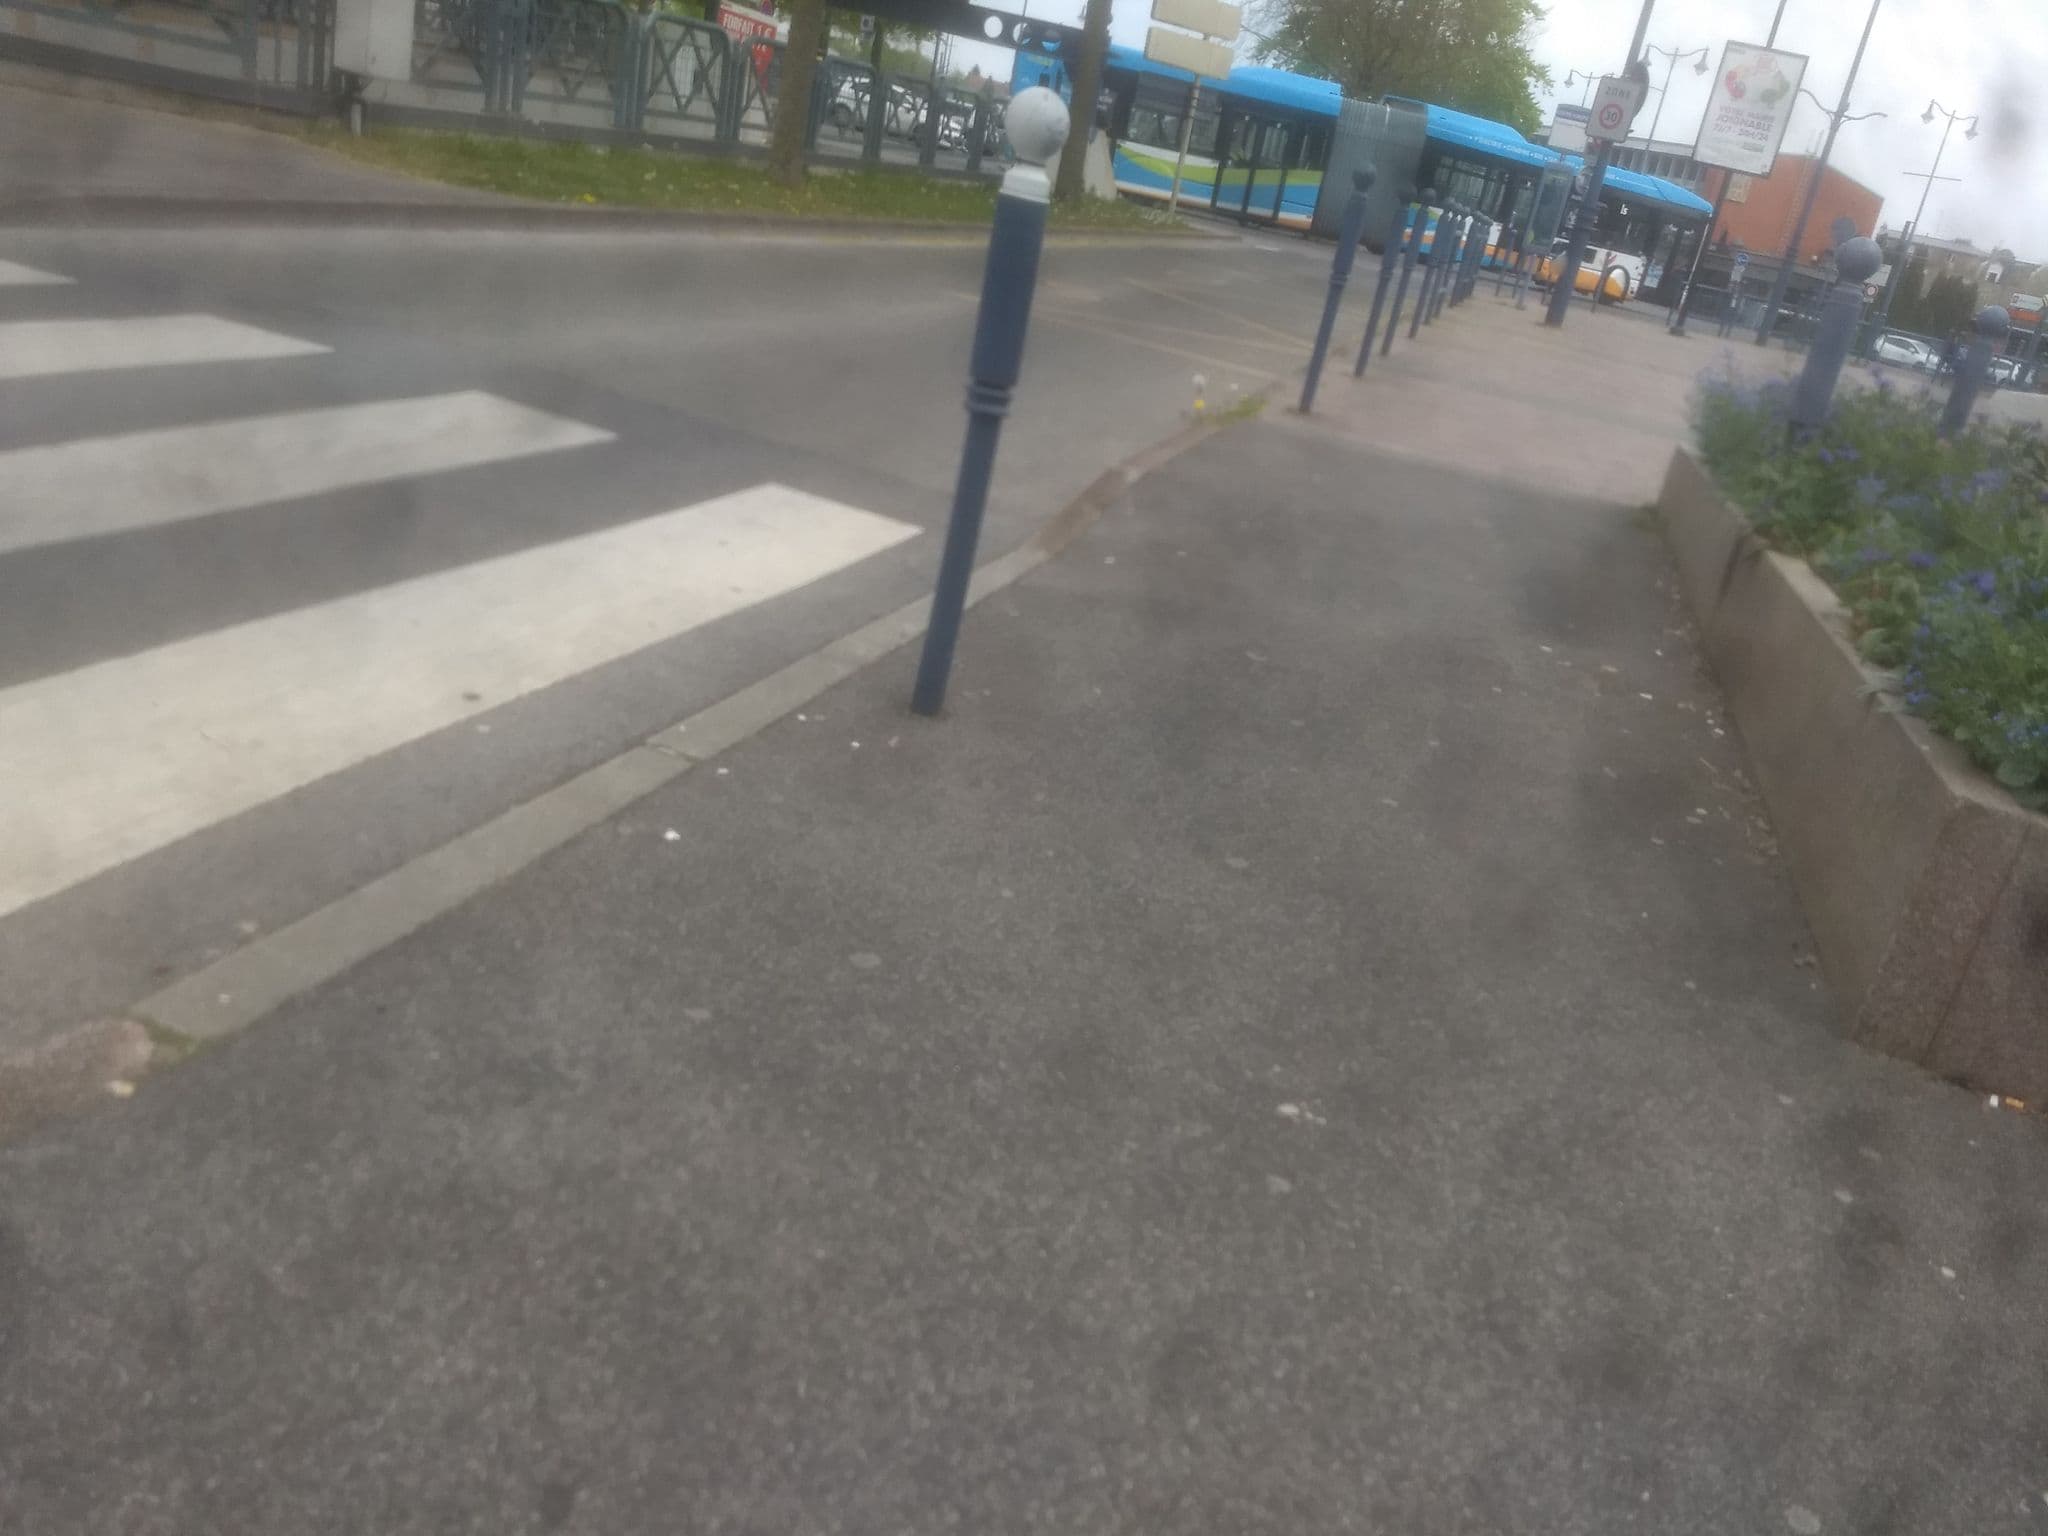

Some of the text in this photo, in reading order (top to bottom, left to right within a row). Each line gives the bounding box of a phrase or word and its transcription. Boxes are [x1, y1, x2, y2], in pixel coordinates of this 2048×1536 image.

[1605, 86, 1631, 98] ZONE
[1604, 111, 1618, 121] 30
[1716, 114, 1775, 132] JOIGNABLE
